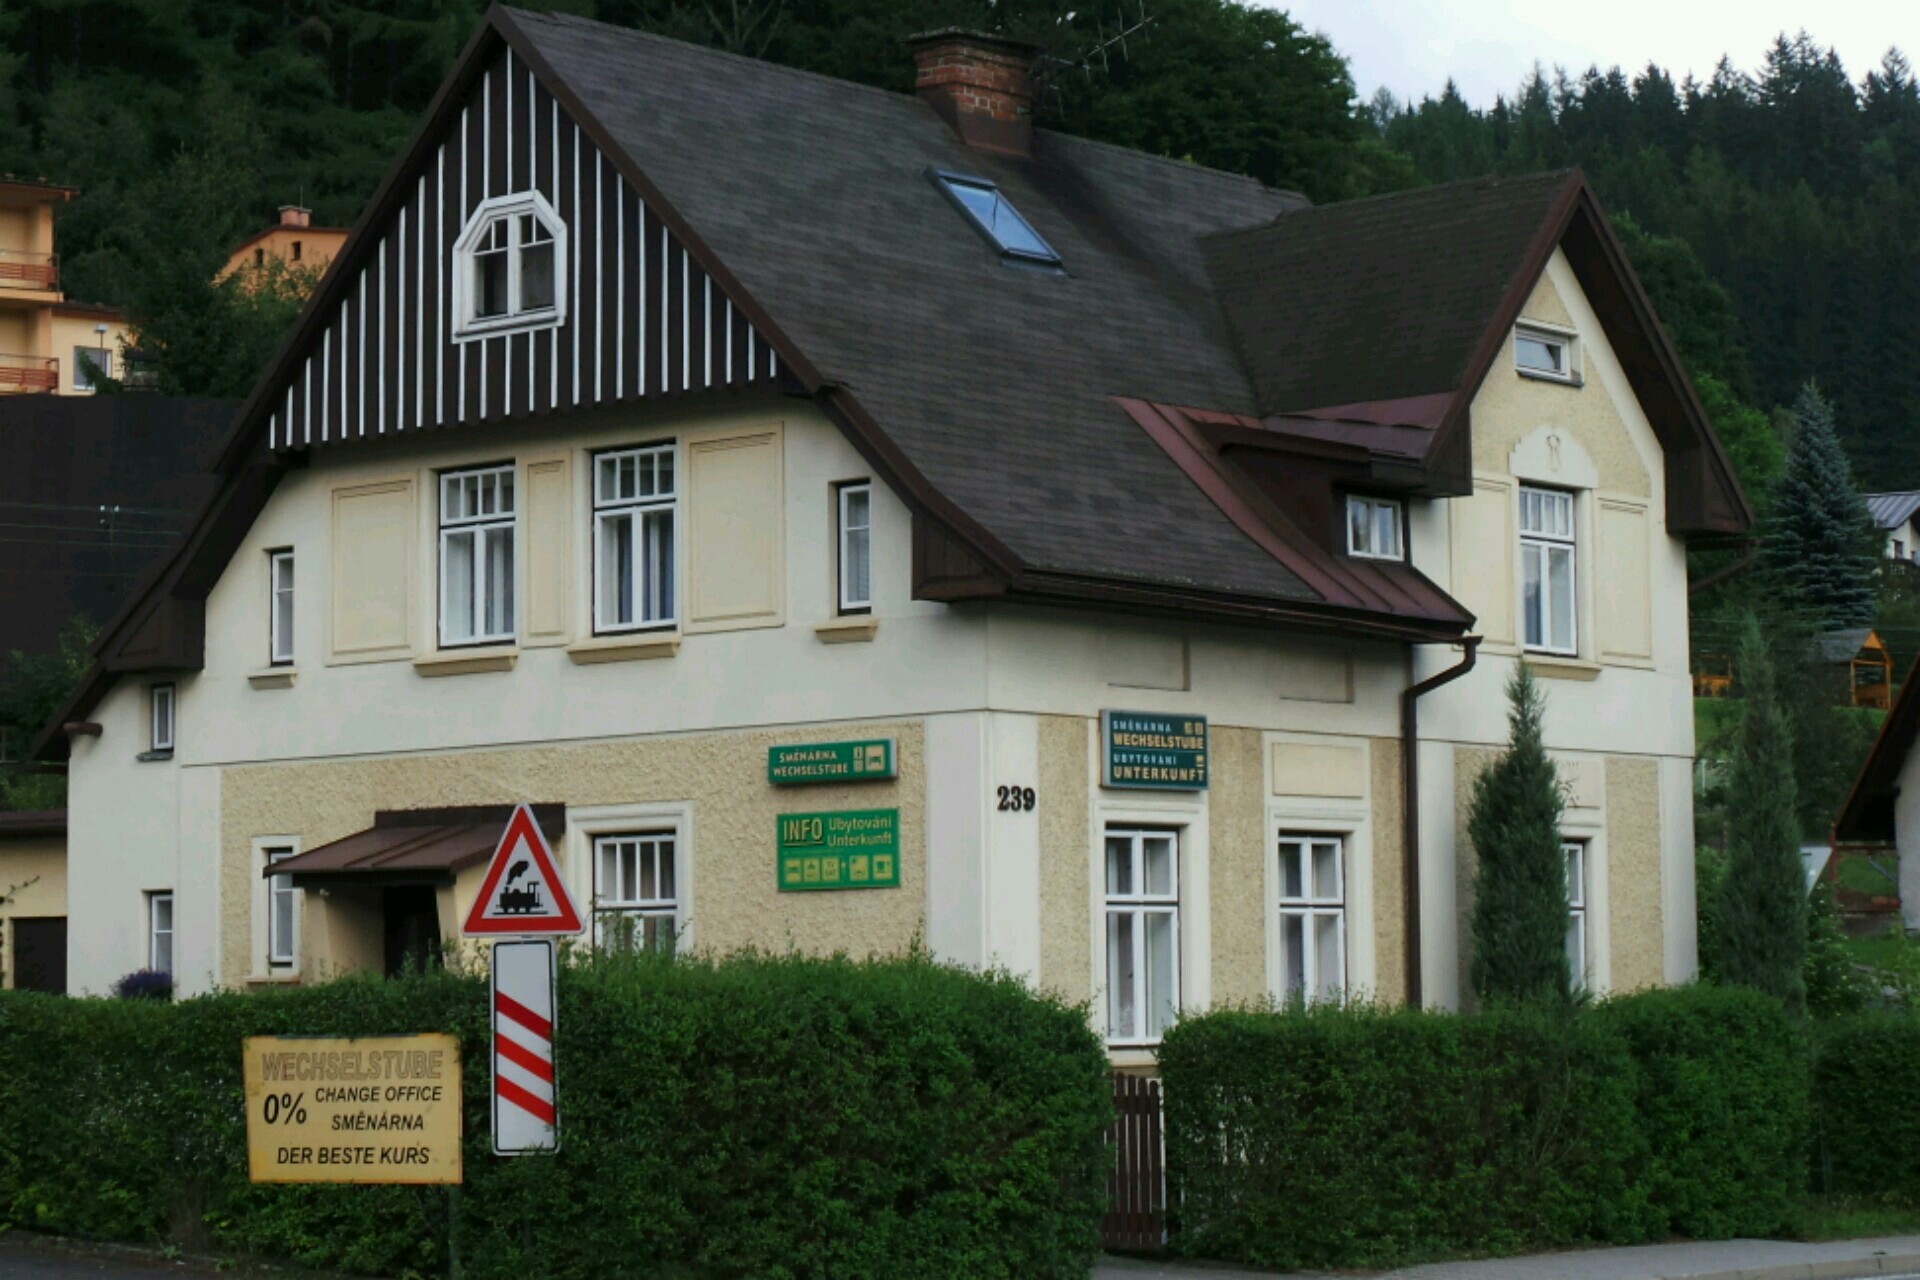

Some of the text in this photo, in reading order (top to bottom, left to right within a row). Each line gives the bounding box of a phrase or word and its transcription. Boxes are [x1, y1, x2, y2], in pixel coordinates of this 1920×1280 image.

[1113, 733, 1204, 749] WECHSELSTUBE
[773, 763, 848, 777] WECHSELSTUBE
[1113, 766, 1204, 781] UNTERKUNFT
[997, 786, 1036, 811] 239
[783, 817, 823, 841] INFO
[827, 832, 892, 847] Unterkunft
[262, 1050, 443, 1081] WECHSELSTUBE
[315, 1086, 443, 1102] CHANGE OFFICE
[263, 1092, 307, 1125] 0%
[277, 1147, 430, 1164] DER BESTE KURS
